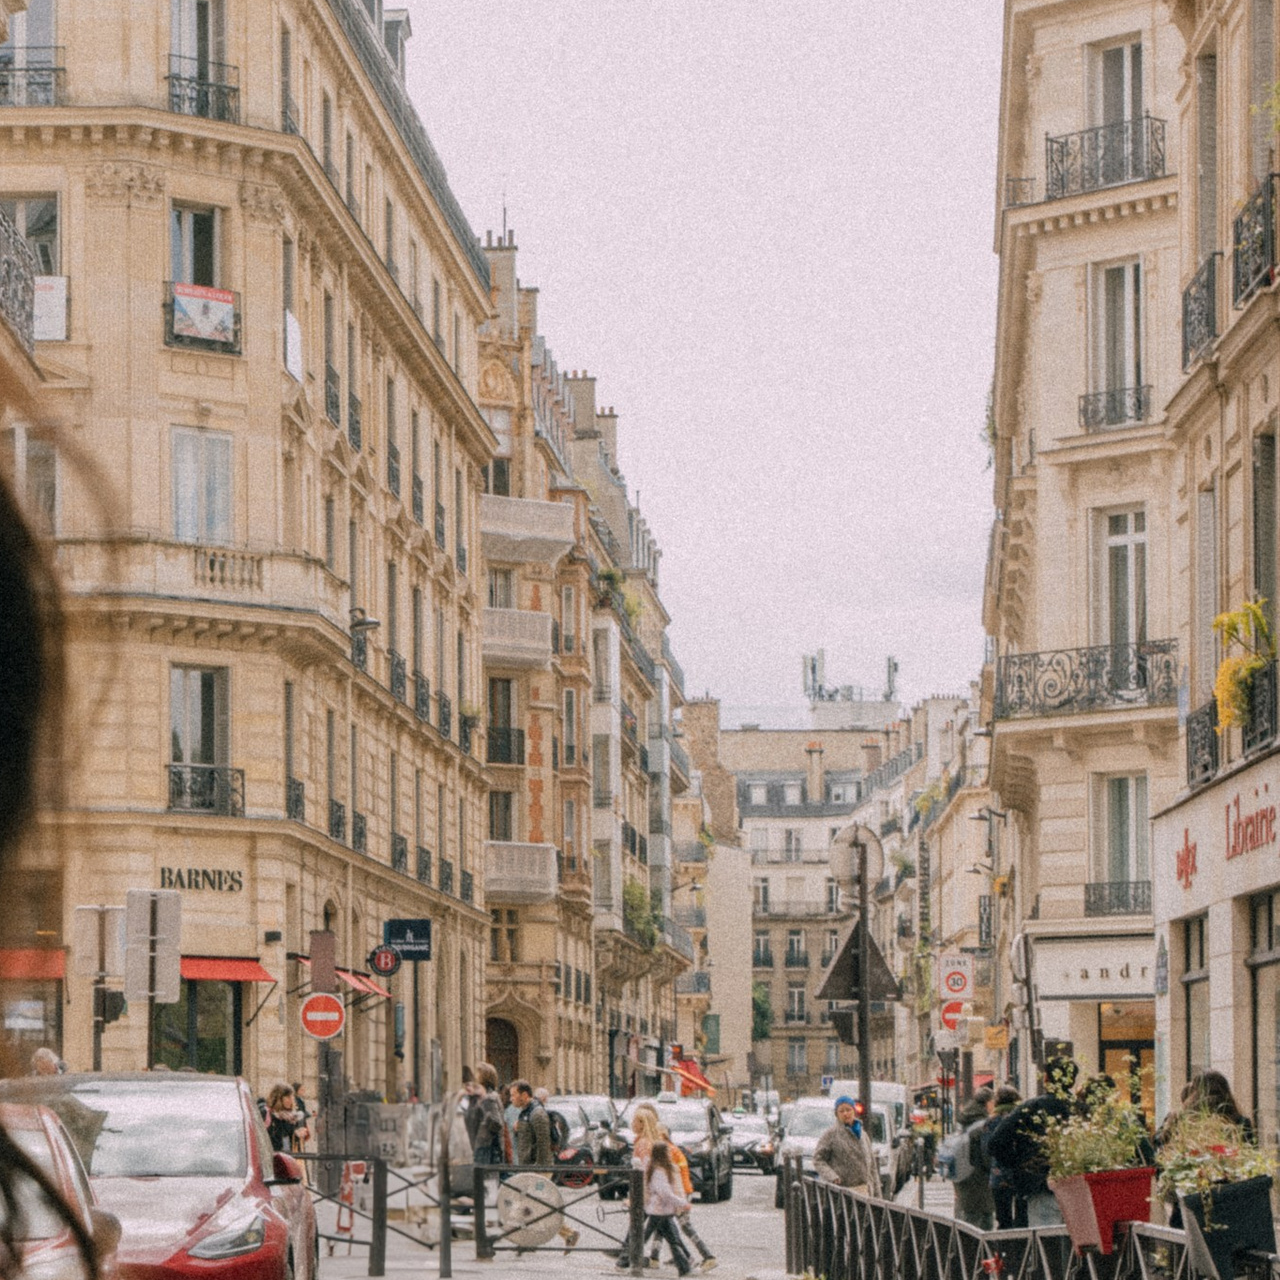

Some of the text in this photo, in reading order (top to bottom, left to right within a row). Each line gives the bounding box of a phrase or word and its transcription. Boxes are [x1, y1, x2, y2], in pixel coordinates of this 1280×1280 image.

[1225, 782, 1276, 861] Librairie
[160, 867, 243, 891] BARNES
[1064, 962, 1148, 980] andr
[950, 977, 963, 987] 30
